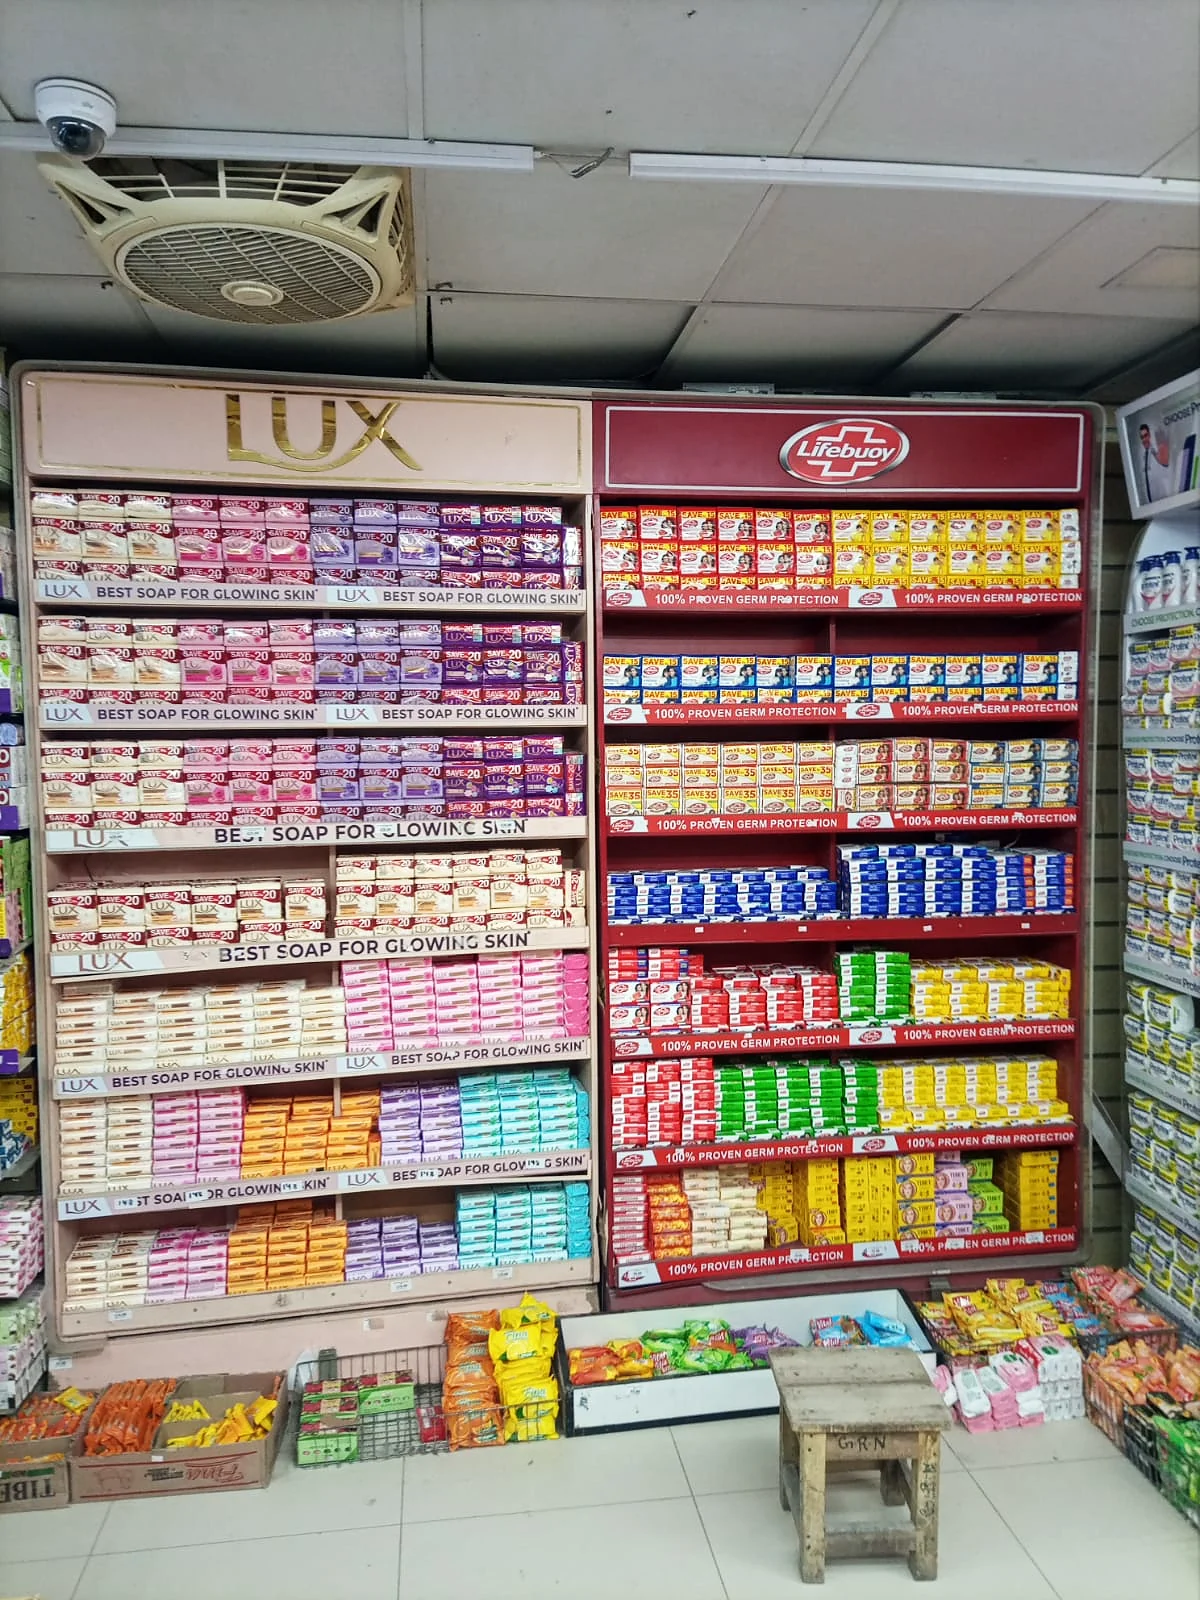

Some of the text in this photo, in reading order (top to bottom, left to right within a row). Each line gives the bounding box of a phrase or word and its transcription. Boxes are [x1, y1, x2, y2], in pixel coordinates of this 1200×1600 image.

[226, 394, 423, 472] LUX
[797, 441, 896, 462] Lifebuoy
[45, 584, 82, 599] LUX
[97, 587, 132, 597] BEST
[139, 588, 176, 598] SOAP
[181, 589, 209, 599] FOR
[214, 589, 280, 600] GLOWING
[337, 589, 370, 602] LUX
[384, 591, 417, 601] BEST
[419, 592, 453, 603] SOAP
[458, 593, 482, 603] FOR
[487, 593, 547, 603] GLOWING
[655, 594, 685, 604] 100%
[736, 596, 767, 604] GERM
[905, 594, 934, 603] 100%
[937, 594, 980, 603] PROVEN
[983, 594, 1013, 603] GERM
[45, 708, 83, 720] LUX
[98, 709, 133, 719] BEST
[138, 710, 176, 720] SOAP
[182, 709, 209, 719] FOR
[214, 710, 279, 720] GLOWING
[336, 708, 369, 720] LUX
[382, 709, 414, 719] BEST
[418, 709, 452, 719] SOAP
[457, 708, 481, 718] FOR
[486, 708, 543, 718] GLOWING
[655, 707, 836, 718] 100% PROVEN GERM PROTECTION
[902, 703, 1078, 715] 100% PROVEN GERM PROTECTION
[783, 789, 794, 797] 35
[657, 820, 686, 830] 100%
[737, 820, 767, 828] GERM
[903, 816, 931, 826] 100%
[934, 816, 975, 825] PROVEN
[273, 827, 327, 841] SOAP
[336, 825, 375, 839] FOR
[77, 896, 91, 905] 20
[125, 896, 139, 905] 20
[219, 946, 270, 962] BEST
[277, 944, 331, 958] SOAP
[339, 940, 378, 955] FOR
[386, 935, 478, 952] GLOWING
[79, 953, 134, 971] LUX
[904, 1024, 1075, 1040] 100% PROVEN GERM PROTECTION
[662, 1035, 839, 1051] 100% PROVEN GERM PROTECTION
[392, 1054, 421, 1065] BEST
[465, 1049, 489, 1059] FOR
[493, 1044, 551, 1057] GLOWING
[347, 1056, 378, 1069] LUX
[61, 1078, 98, 1092] LUX
[112, 1076, 148, 1088] BEST
[152, 1073, 188, 1085] SOAP
[194, 1070, 221, 1081] FOR
[907, 1138, 935, 1148] 100%
[938, 1136, 979, 1146] PROVEN
[982, 1134, 1010, 1144] GERM
[666, 1153, 695, 1162] 100%
[699, 1150, 741, 1160] PROVEN
[745, 1148, 774, 1157] GERM
[348, 1173, 380, 1185] LUX
[393, 1171, 416, 1181] BES
[438, 1166, 461, 1177] OAP
[465, 1164, 489, 1175] FOR
[228, 1184, 281, 1198] GLOWIN
[65, 1200, 101, 1213] LUX
[937, 1240, 978, 1249] PEN
[982, 1238, 1010, 1248] GERM
[1013, 1234, 1075, 1244] PRCTION
[668, 1264, 697, 1274] 100%
[701, 1260, 743, 1271] PROVEN
[746, 1257, 775, 1267] GERM
